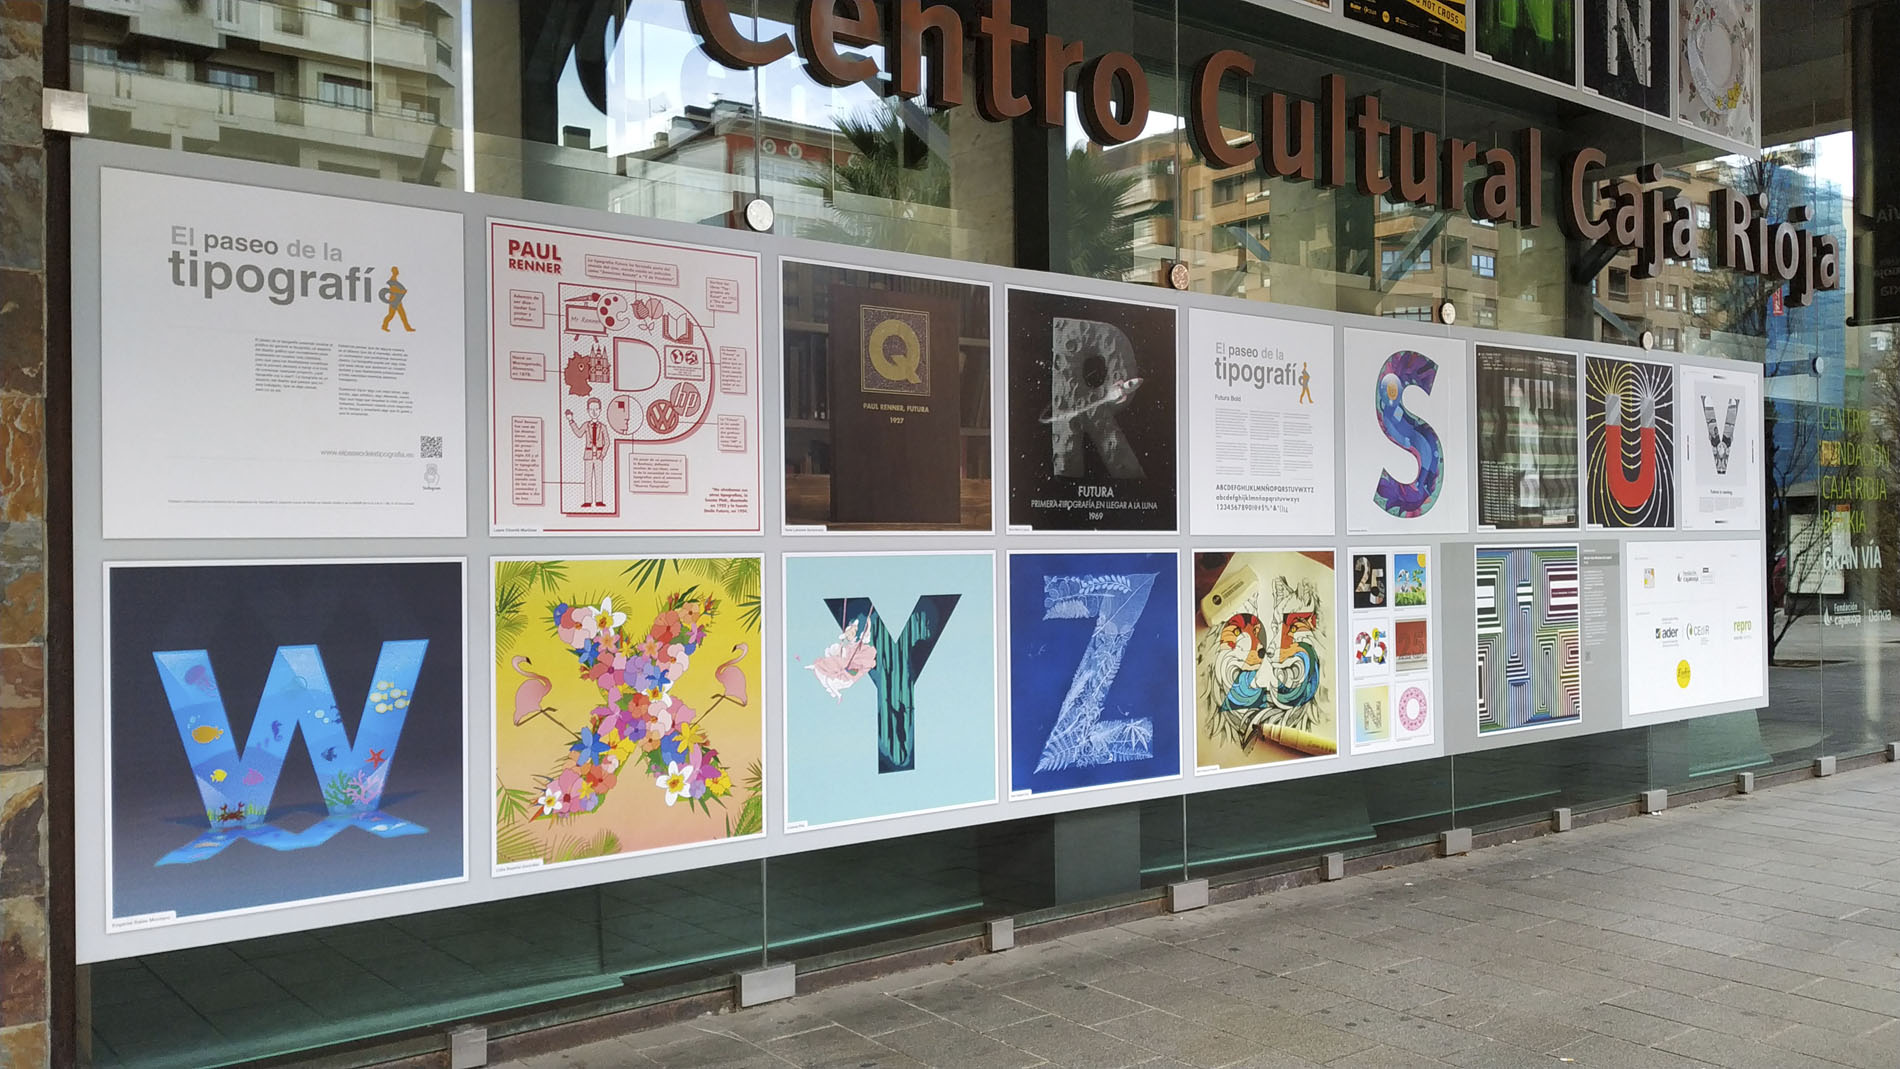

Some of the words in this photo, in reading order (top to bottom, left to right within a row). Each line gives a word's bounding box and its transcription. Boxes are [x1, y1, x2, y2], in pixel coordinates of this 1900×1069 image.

[1437, 6, 1459, 25] CROSS
[696, 0, 1149, 145] Centro
[1196, 50, 1542, 228] Cultural
[1568, 147, 1699, 278] Caja
[1722, 187, 1840, 307] Rioja
[170, 225, 195, 247] El
[204, 233, 278, 256] paseo
[287, 240, 316, 260] de
[323, 243, 343, 263] la
[508, 239, 562, 262] PAUL
[508, 258, 562, 275] RENNER
[869, 319, 922, 384] Q
[1216, 342, 1226, 355] El
[1228, 345, 1259, 359] paseo
[1261, 347, 1273, 360] de
[1275, 349, 1284, 361] la
[674, 382, 699, 414] hp
[863, 402, 879, 411] PAUL
[880, 404, 906, 413] RENNER,
[907, 405, 930, 414] FUTURA
[1052, 317, 1147, 479] R
[889, 416, 904, 425] 1927
[1373, 350, 1445, 519] S
[1700, 394, 1740, 475] V
[1821, 407, 1871, 433] CENTRO
[1504, 376, 1554, 508] T
[1605, 393, 1656, 508] U
[1078, 486, 1114, 498] FUTURA
[1822, 475, 1852, 501] CAJA
[1855, 479, 1887, 500] RIOJA
[1031, 500, 1058, 508] PRIMERA
[1095, 500, 1105, 509] EN
[1105, 501, 1127, 509] LLEGAR
[1134, 501, 1142, 510] LA
[1142, 502, 1158, 510] LUNA
[1088, 512, 1104, 521] 1969
[1823, 546, 1859, 571] GRAN
[1862, 539, 1883, 570] VÍA
[1355, 556, 1385, 605] 25
[1397, 568, 1424, 593] 25
[1662, 627, 1679, 639] ader
[1733, 620, 1752, 634] repro
[1355, 627, 1387, 665] 25
[823, 593, 963, 775] Y
[1033, 571, 1160, 775] Z
[535, 595, 722, 820] X
[1363, 700, 1383, 731] N
[152, 639, 430, 829] W
